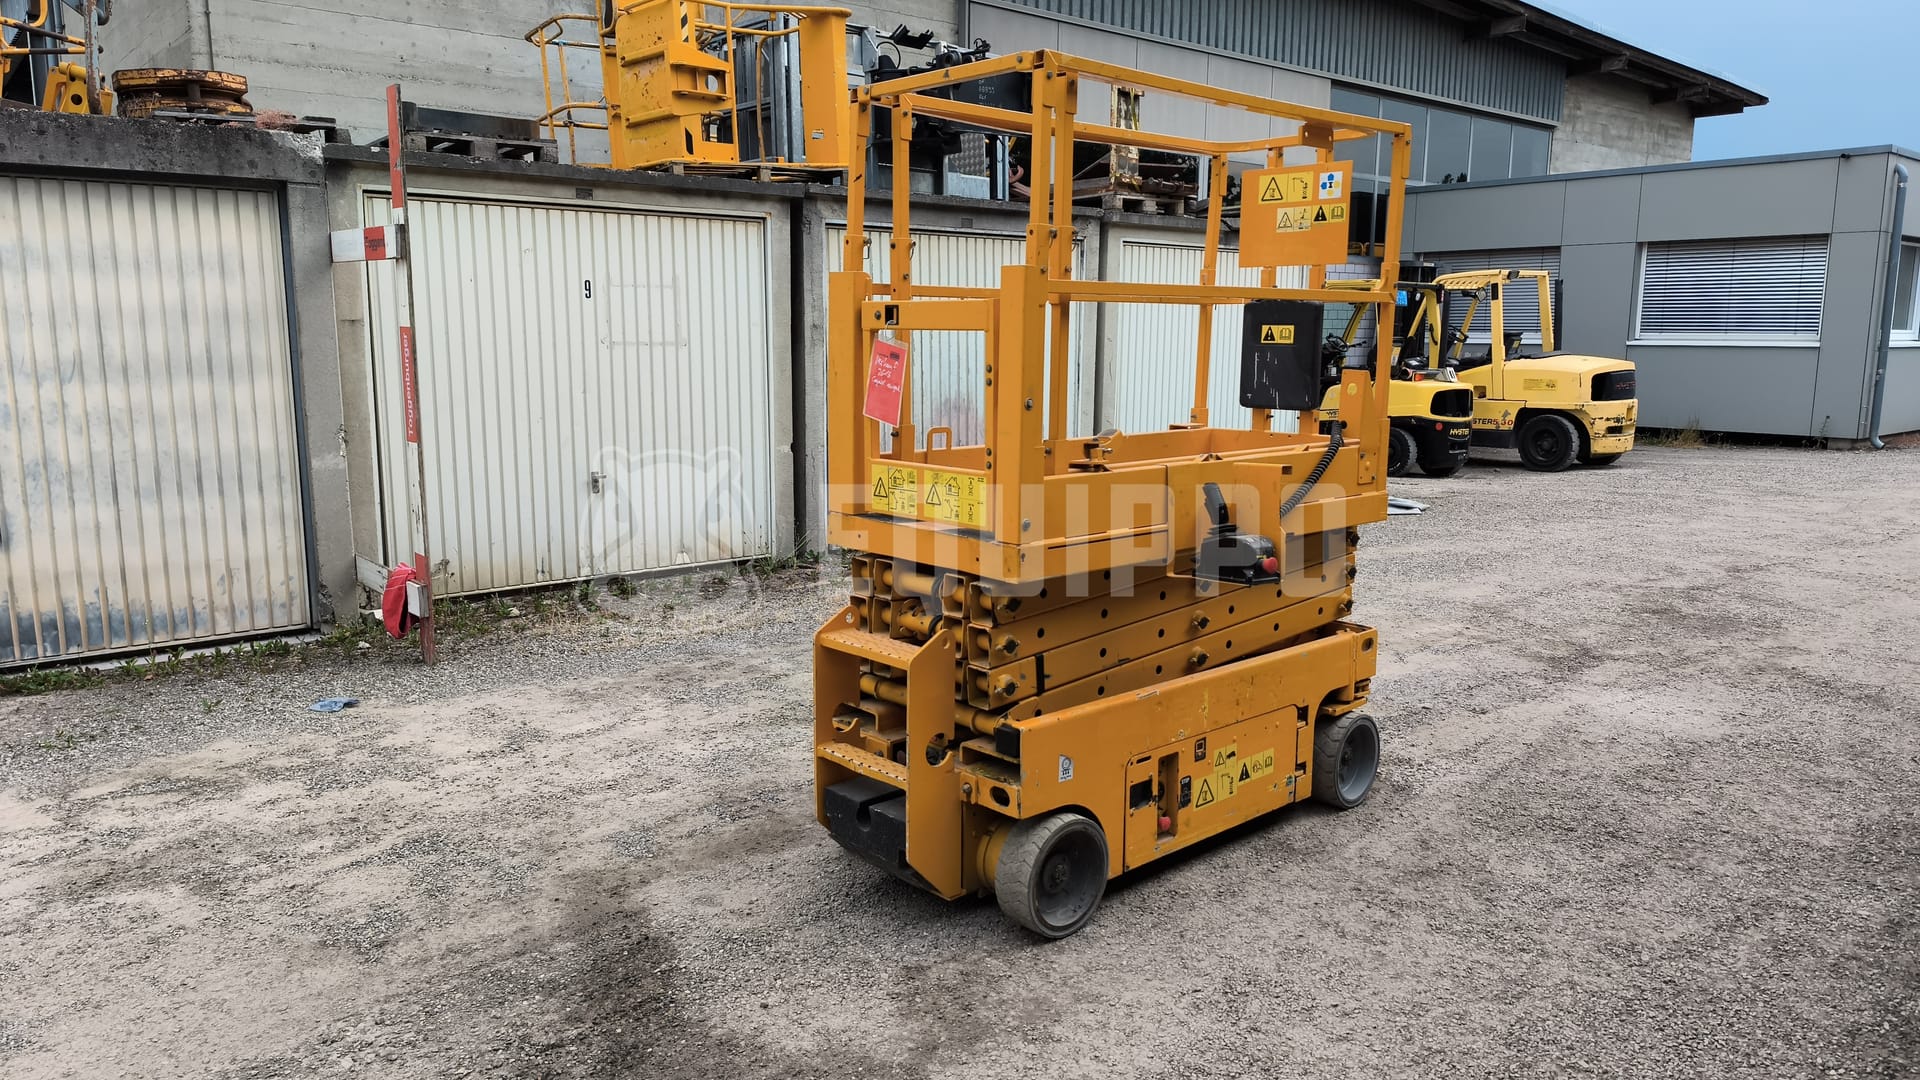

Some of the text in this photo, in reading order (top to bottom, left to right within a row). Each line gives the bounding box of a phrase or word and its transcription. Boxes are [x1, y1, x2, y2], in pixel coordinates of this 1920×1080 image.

[584, 279, 592, 299] 9
[403, 332, 414, 437] Toggenburger
[1472, 417, 1493, 425] STER
